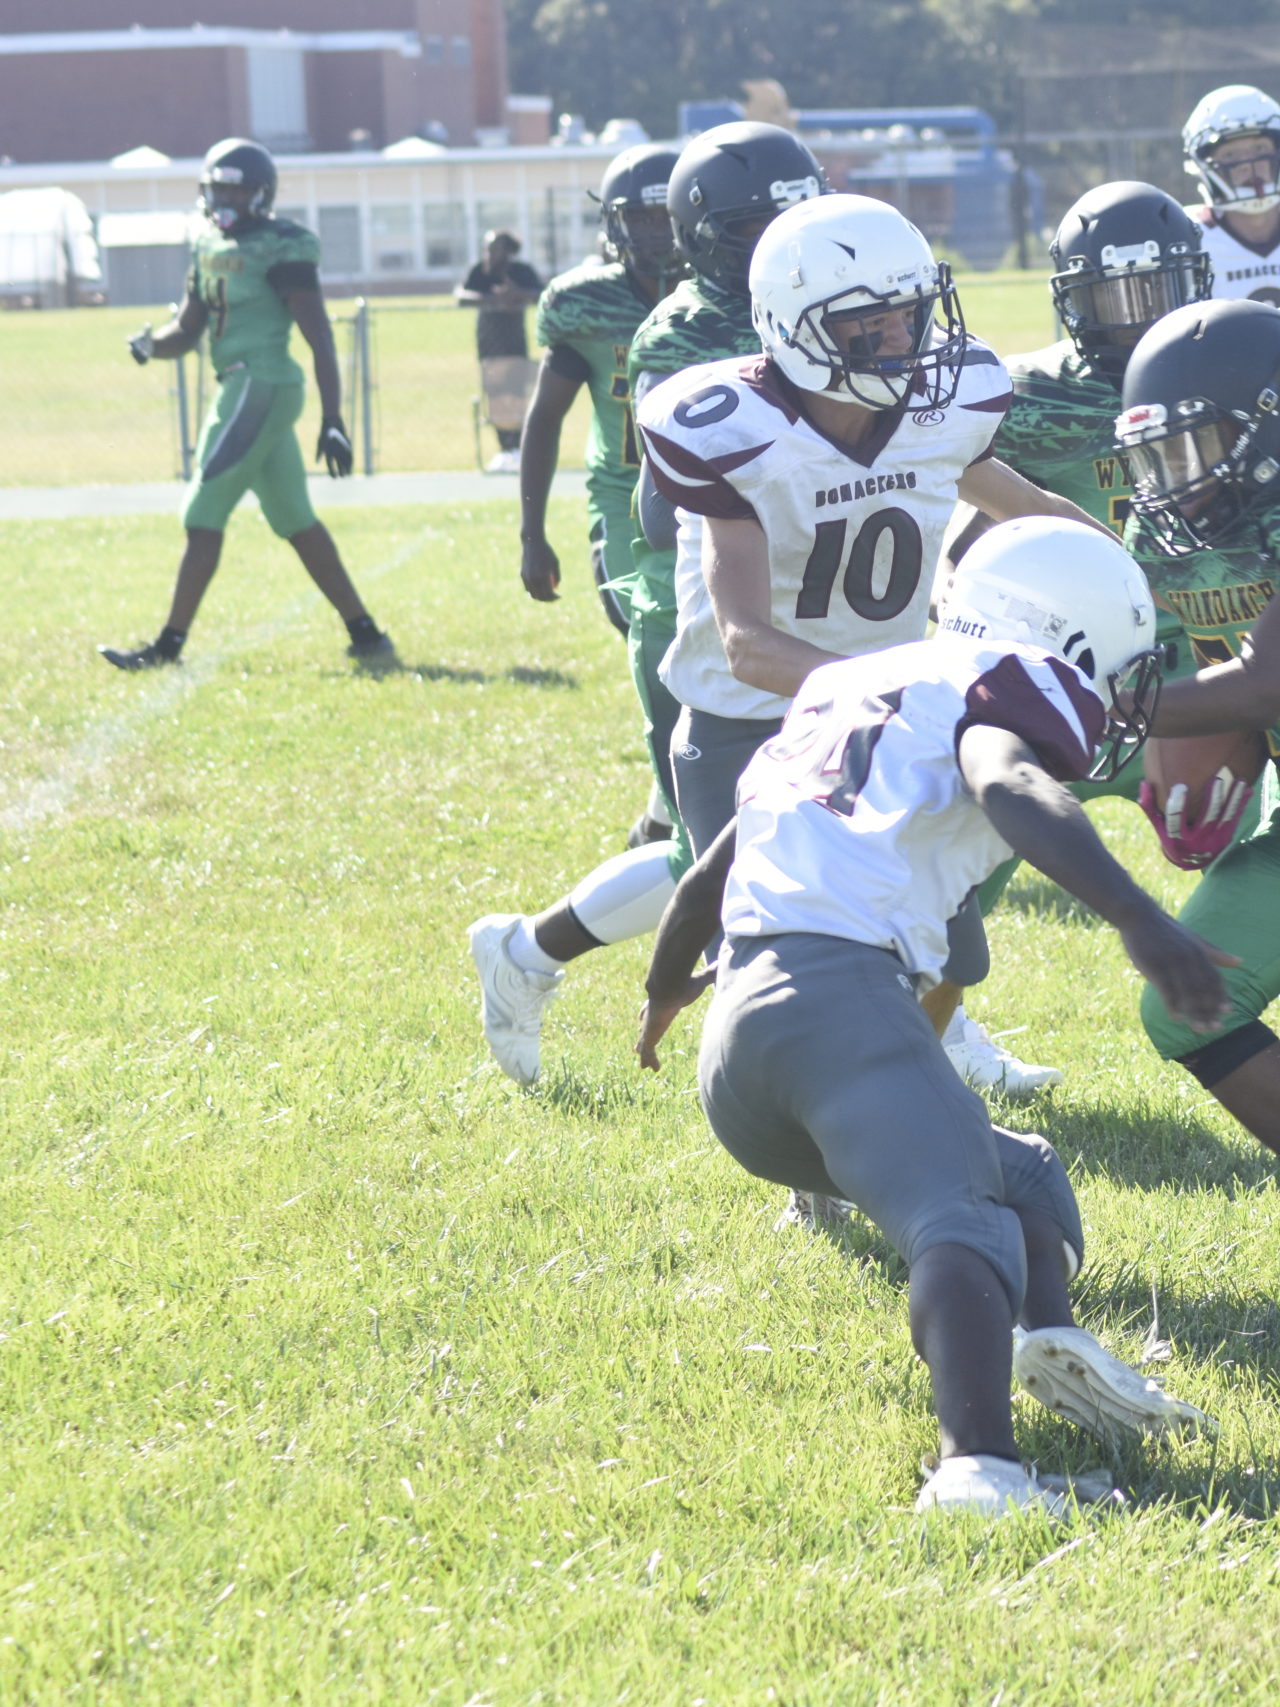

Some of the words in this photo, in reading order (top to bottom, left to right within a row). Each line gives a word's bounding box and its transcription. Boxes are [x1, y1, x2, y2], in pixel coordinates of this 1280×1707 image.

[815, 471, 917, 508] BONACKERS
[795, 506, 923, 621] 10
[940, 615, 987, 639] schutt
